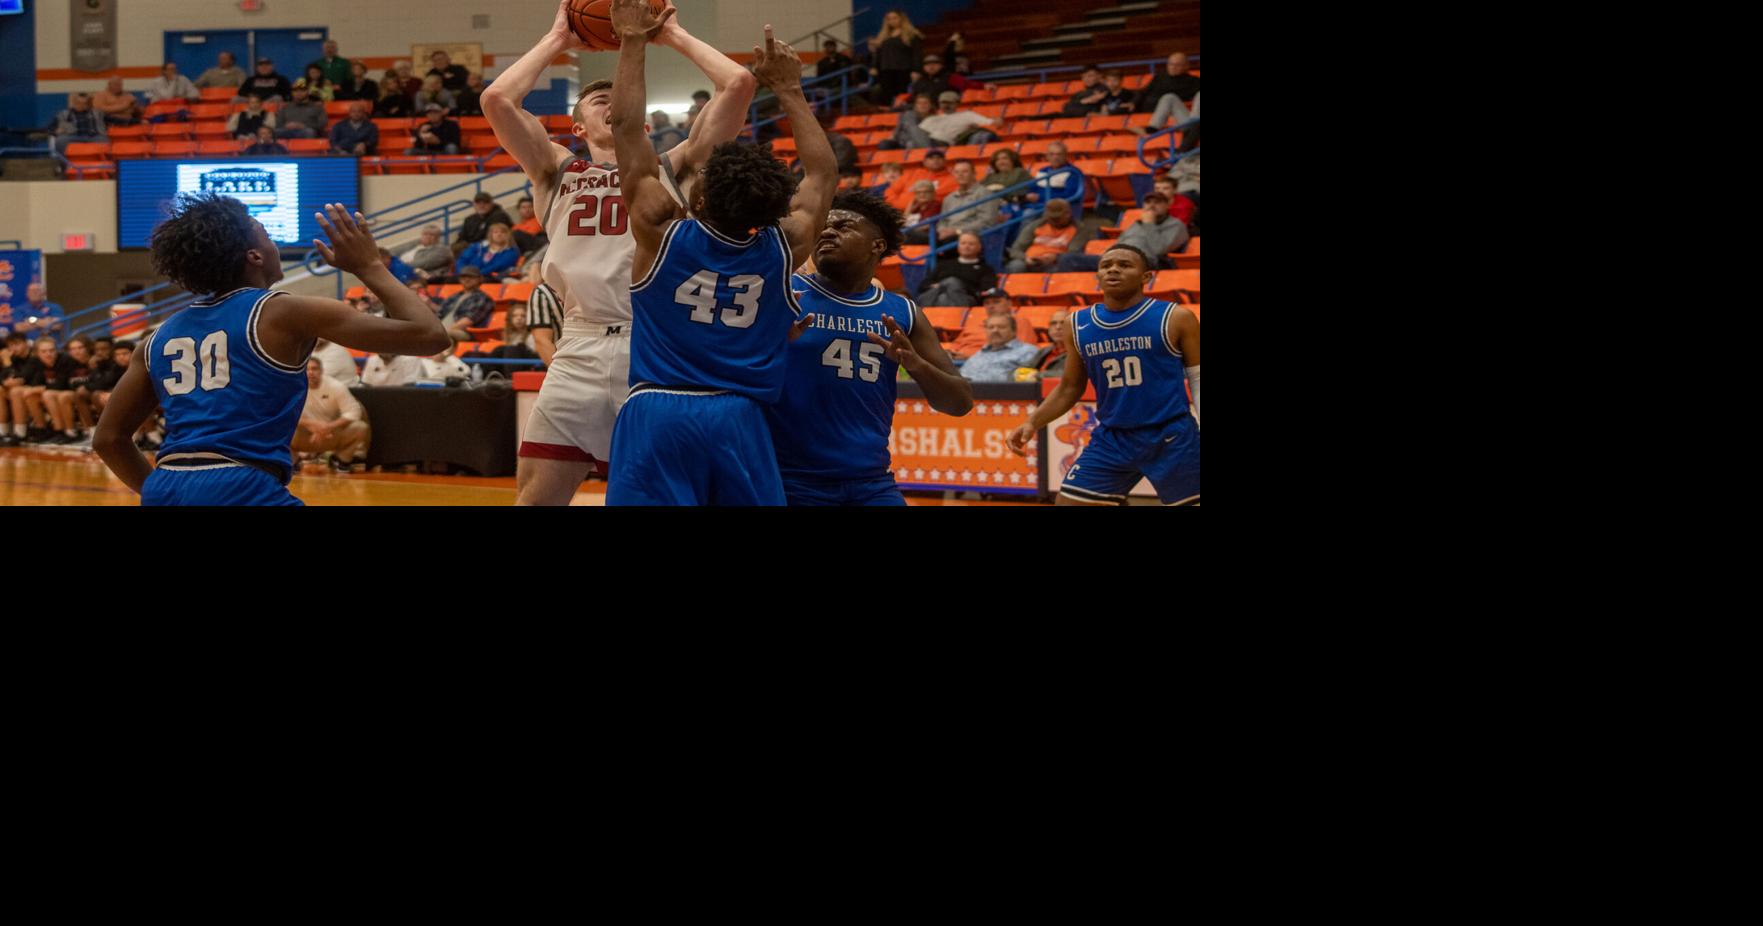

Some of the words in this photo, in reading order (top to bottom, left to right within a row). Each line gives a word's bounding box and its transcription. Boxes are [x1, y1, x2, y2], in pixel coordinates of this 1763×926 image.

[567, 194, 629, 236] 20
[673, 269, 765, 329] 43
[605, 325, 622, 337] M
[807, 312, 893, 338] HARLEST
[821, 338, 885, 383] 45
[1084, 335, 1152, 357] CHARLESTON
[162, 329, 231, 397] 30
[1101, 355, 1143, 389] 20
[888, 426, 1013, 459] SHALS
[1066, 464, 1081, 481] C
